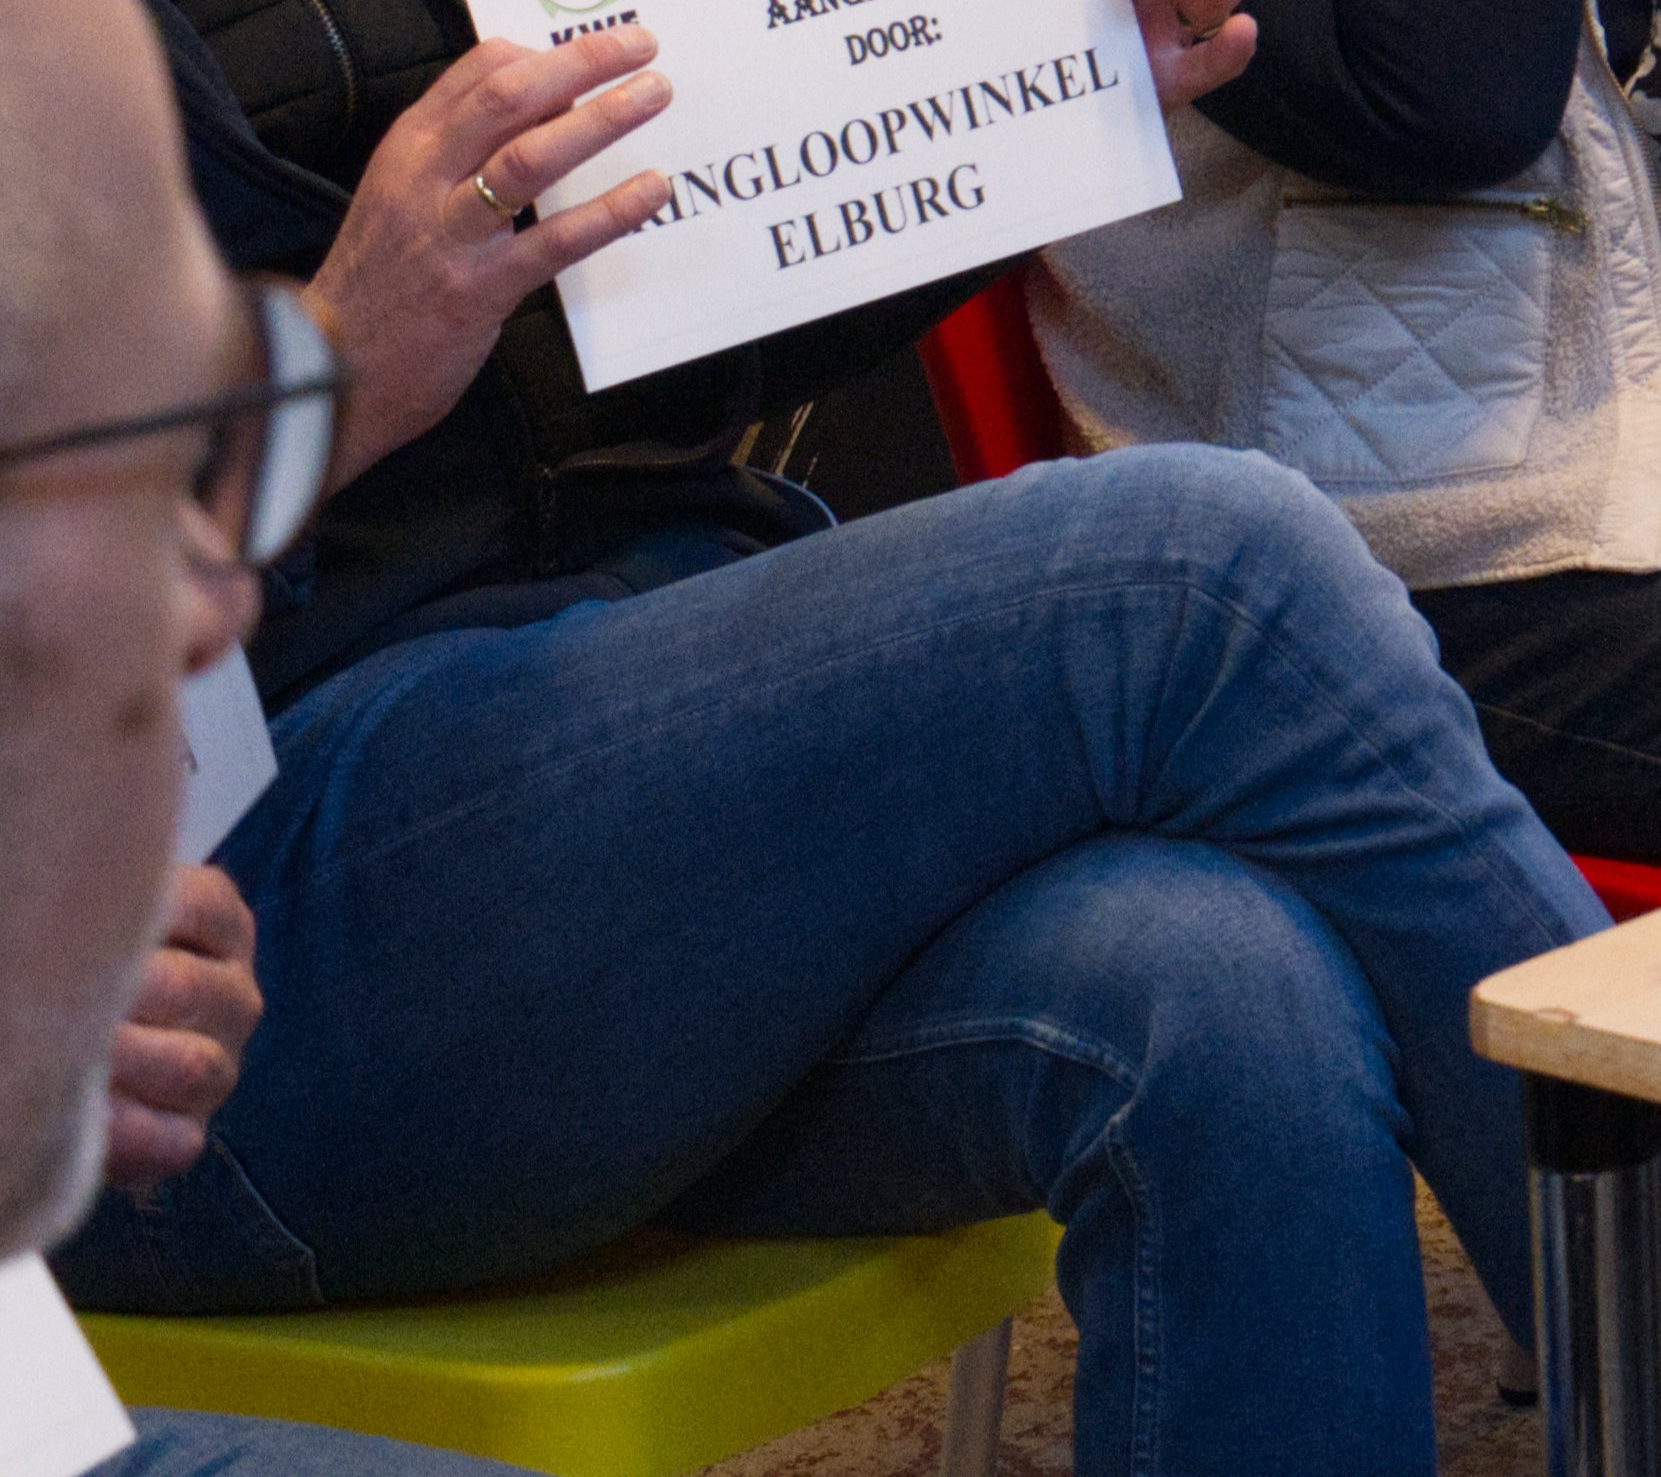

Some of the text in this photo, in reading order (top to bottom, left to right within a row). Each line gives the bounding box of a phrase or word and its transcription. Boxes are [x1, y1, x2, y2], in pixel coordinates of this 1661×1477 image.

[845, 12, 945, 67] DOOR:
[626, 46, 1121, 235] INGLOOPWINKEL
[767, 161, 988, 273] ELBURG
